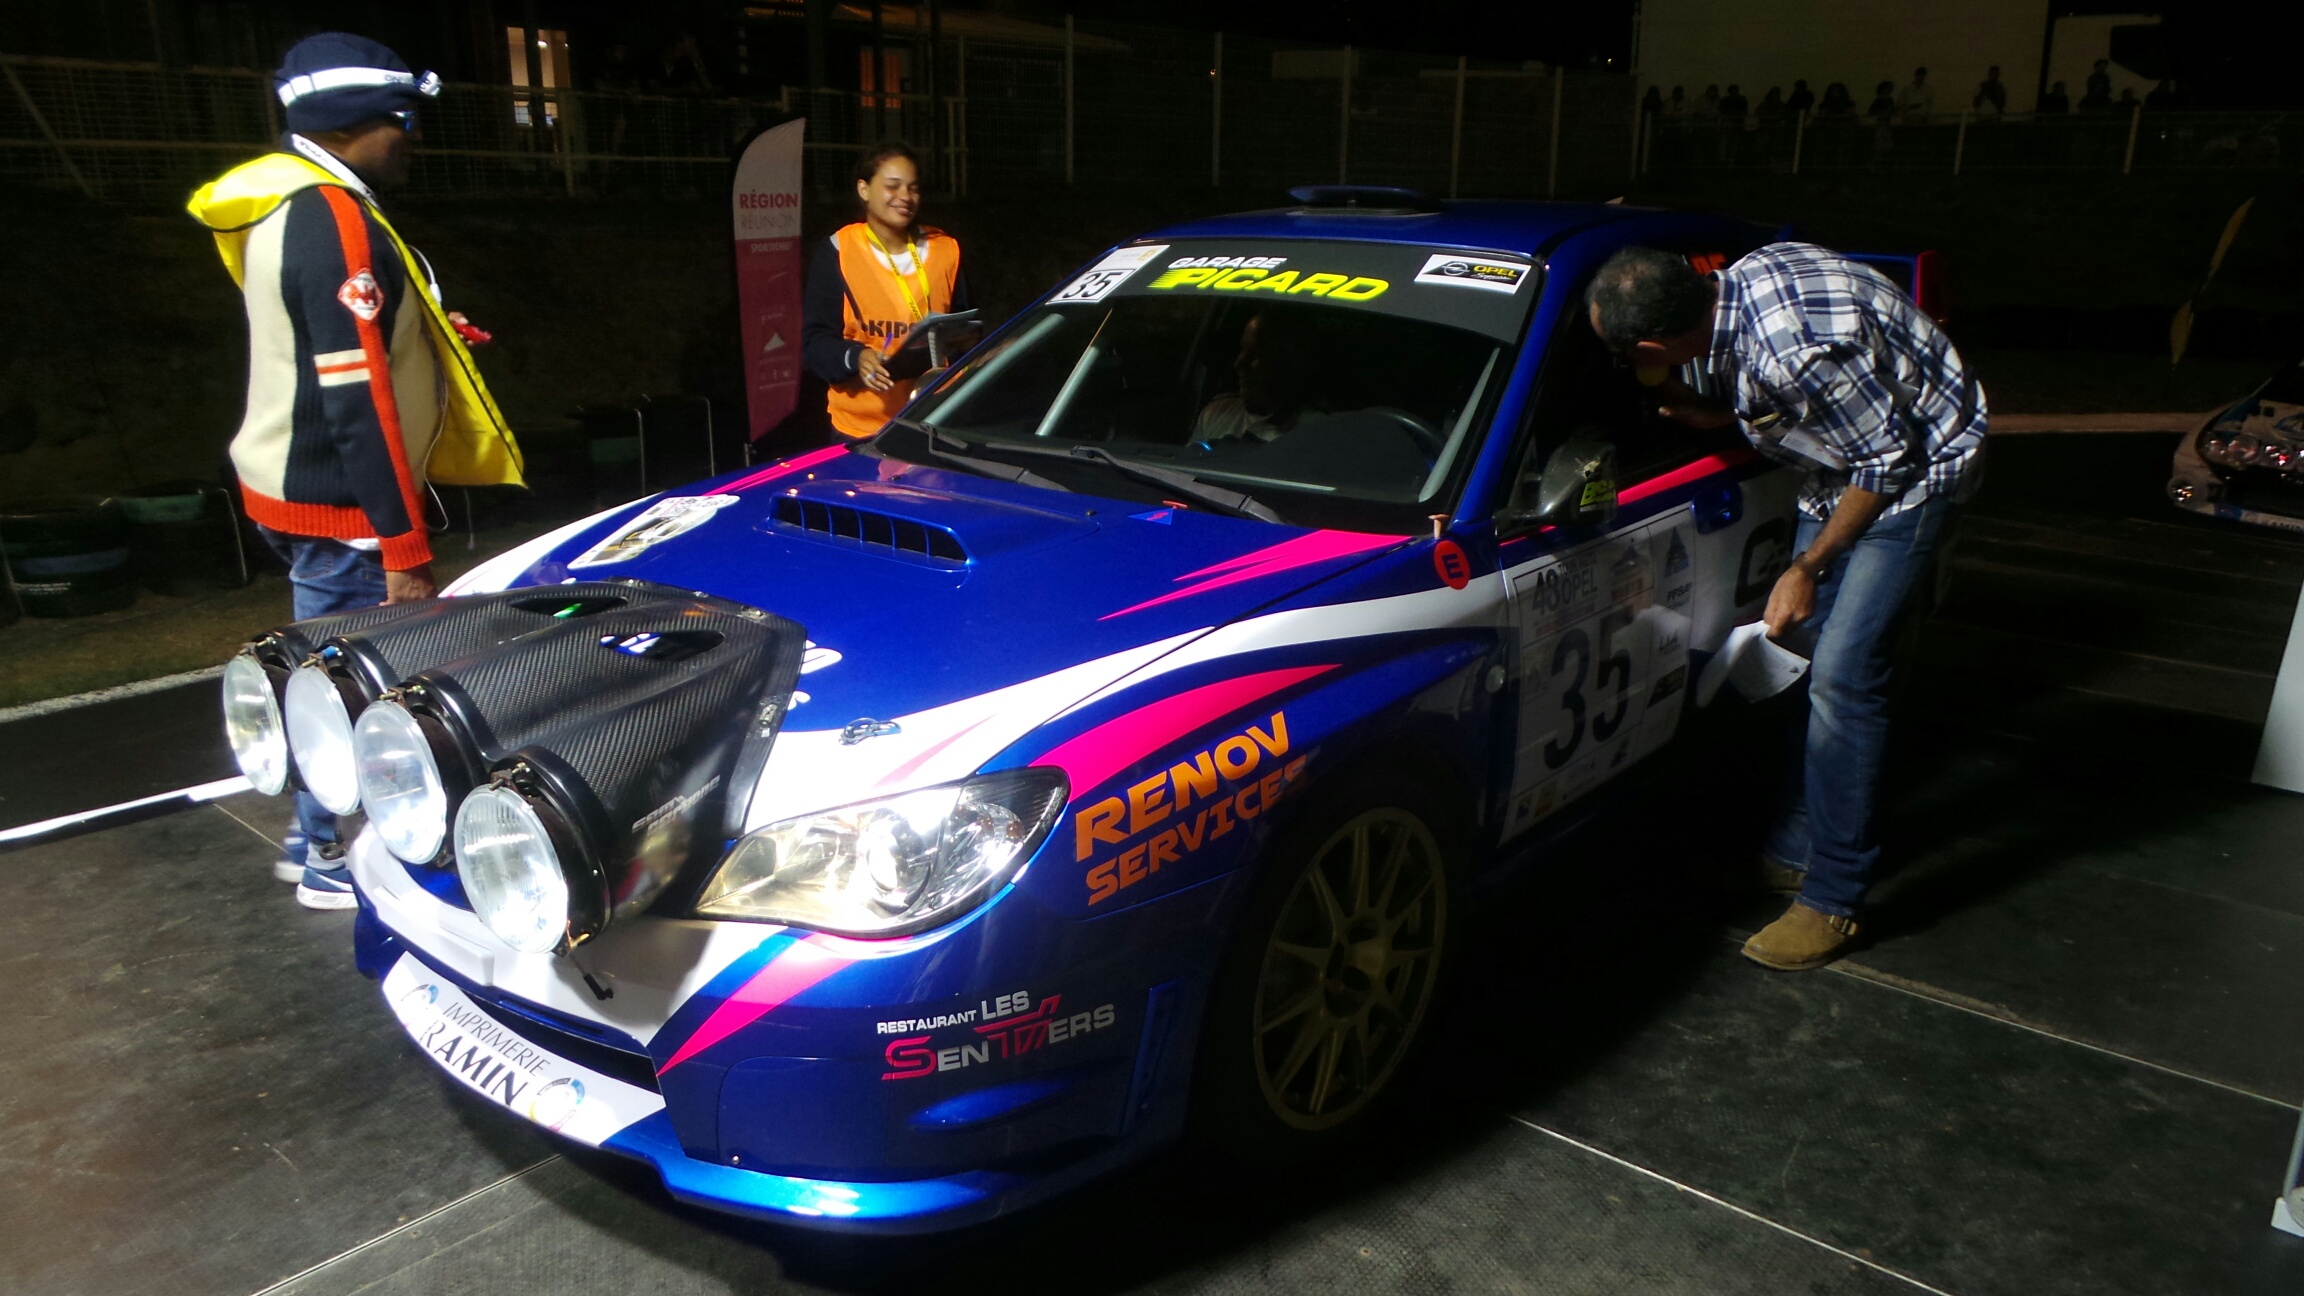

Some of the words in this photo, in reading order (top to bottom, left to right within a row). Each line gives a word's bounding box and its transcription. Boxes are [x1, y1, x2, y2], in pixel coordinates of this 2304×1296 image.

[740, 189, 798, 208] RÉGION
[1168, 256, 1287, 269] GARAGE
[1473, 265, 1518, 277] OPEL
[1062, 271, 1124, 299] 35
[1148, 267, 1389, 300] PICARD
[1441, 553, 1464, 579] E
[1562, 566, 1598, 605] OPEL
[1533, 568, 1560, 615] 48
[1544, 603, 1635, 770] 35
[1076, 711, 1289, 862] RENOV
[1086, 754, 1307, 906] SERVICES
[877, 1009, 977, 1034] RESTAURANT
[981, 990, 1030, 1020] LES
[442, 1001, 551, 1077] IMPRIMERIE
[419, 1020, 529, 1106] RAMIN
